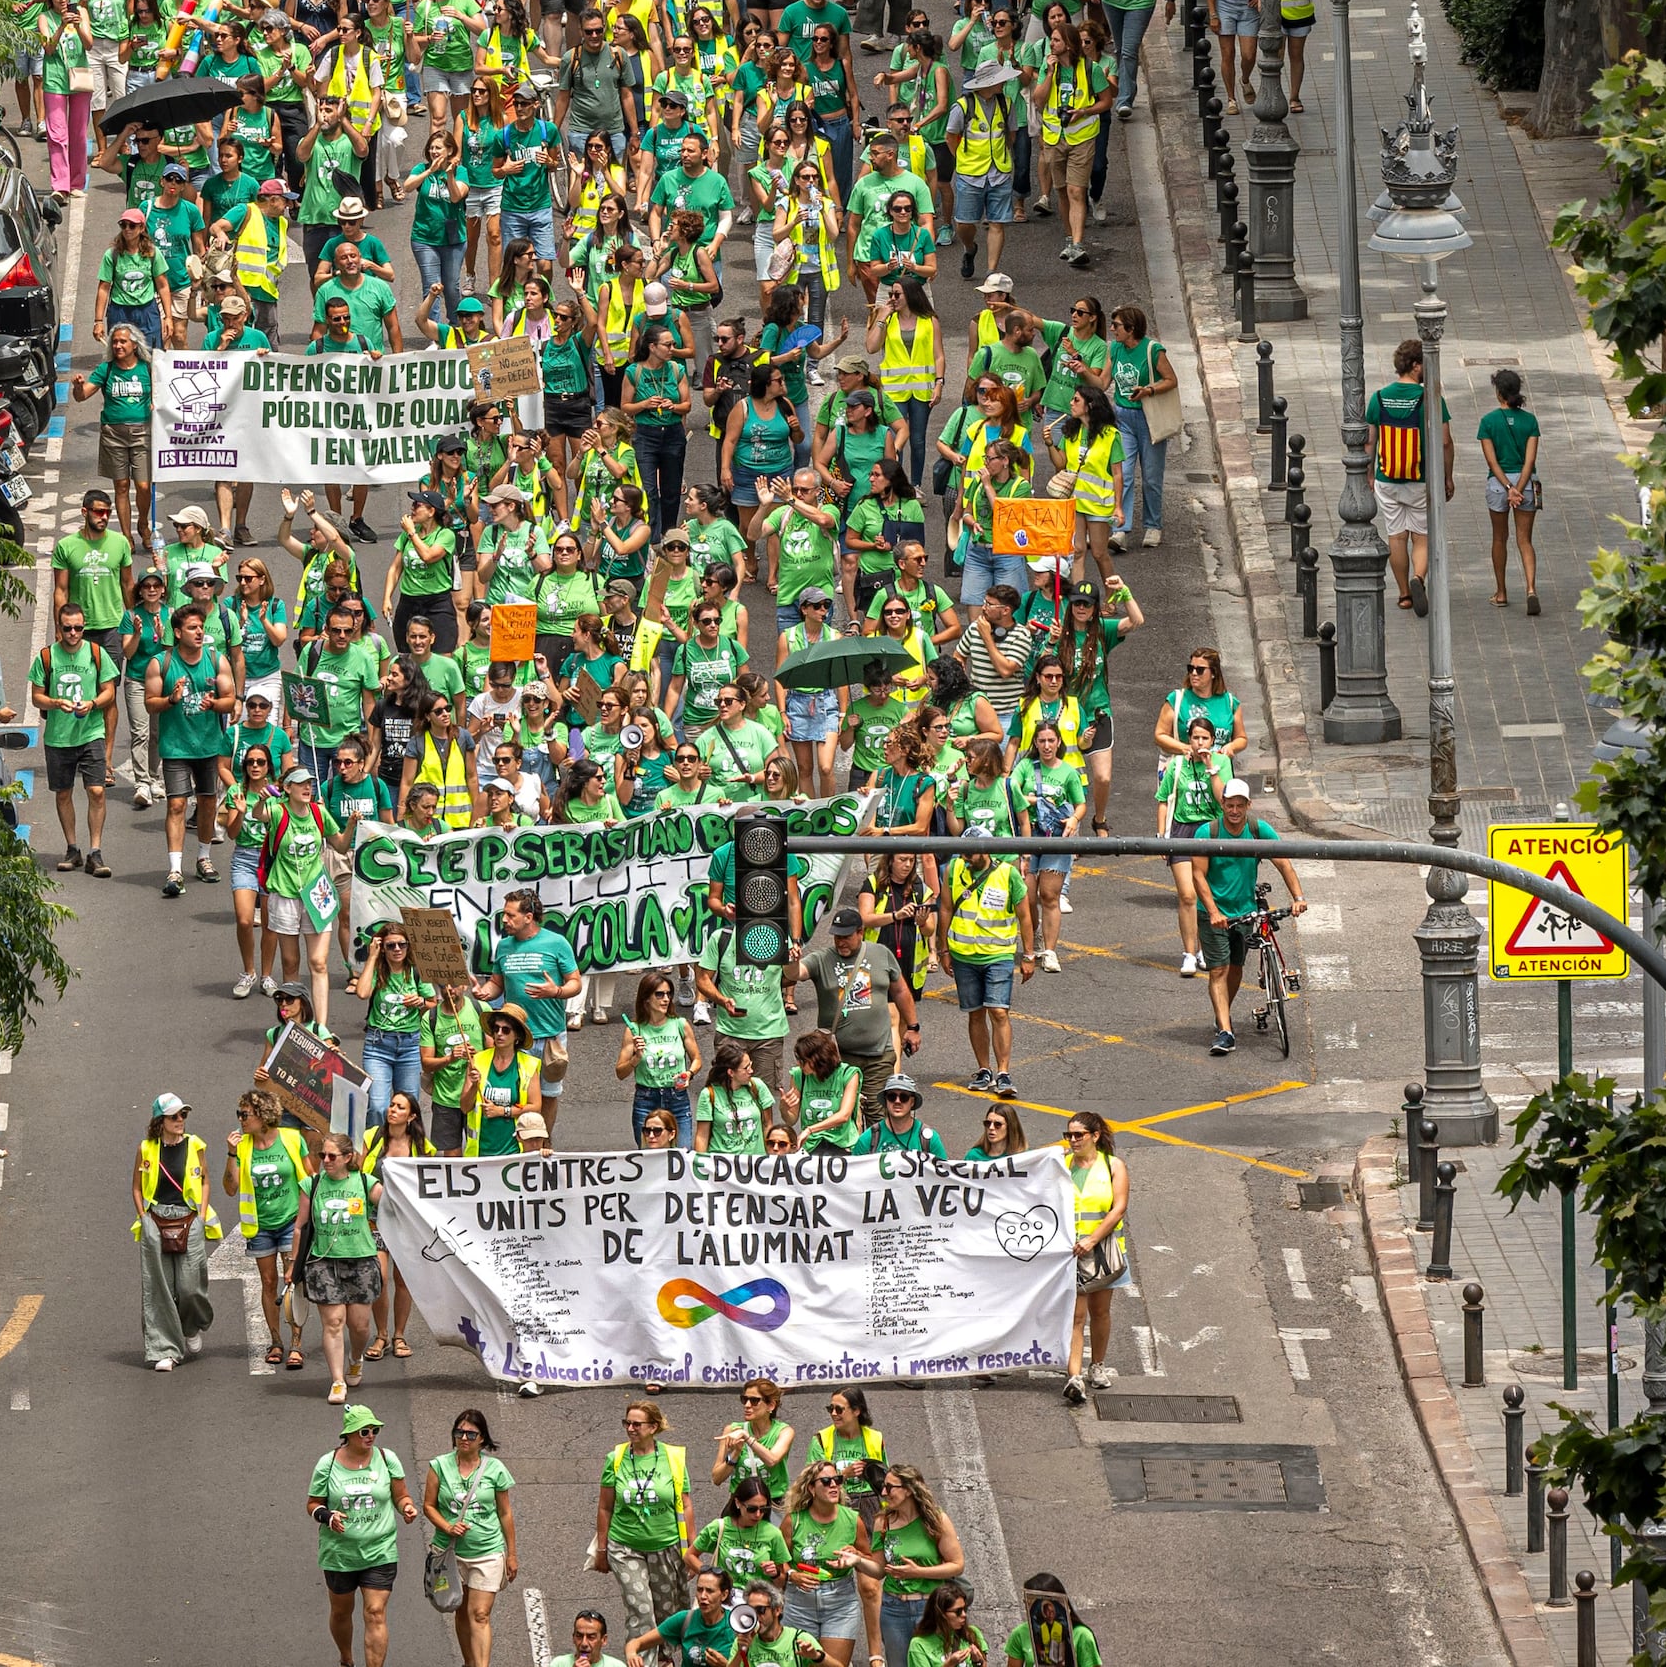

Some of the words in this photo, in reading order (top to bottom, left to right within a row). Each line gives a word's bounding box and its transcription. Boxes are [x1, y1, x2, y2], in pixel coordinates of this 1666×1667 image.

[242, 360, 381, 394] DEFENSEM
[499, 358, 510, 370] NO
[262, 395, 373, 433] PÚBLICA,
[376, 401, 405, 429] DE
[161, 451, 177, 466] IES
[178, 450, 236, 466] L'ELIANA
[310, 437, 319, 466] I
[325, 437, 356, 466] EN
[996, 500, 1069, 530] FALTAN
[1507, 833, 1610, 855] ATENCIÓ
[1517, 956, 1602, 972] ATENCIÓN
[288, 1029, 325, 1061] SEGUIREM
[275, 1067, 287, 1079] TO
[286, 1074, 299, 1088] BE
[416, 1163, 481, 1199] ELS
[501, 1153, 644, 1193] CENTRES
[879, 1150, 1029, 1181] ESPECIAL
[584, 1192, 638, 1226] PER
[665, 1191, 832, 1229] DEFENSAR
[862, 1188, 901, 1224] LA
[915, 1184, 985, 1217] VEU
[602, 1228, 644, 1266] DE
[677, 1229, 854, 1267] L'ALUMNAT
[629, 1352, 693, 1382] especial
[795, 1351, 881, 1381] resisteix
[892, 1355, 899, 1376] i
[909, 1354, 971, 1376] mereix
[977, 1339, 1059, 1370] respecte.
